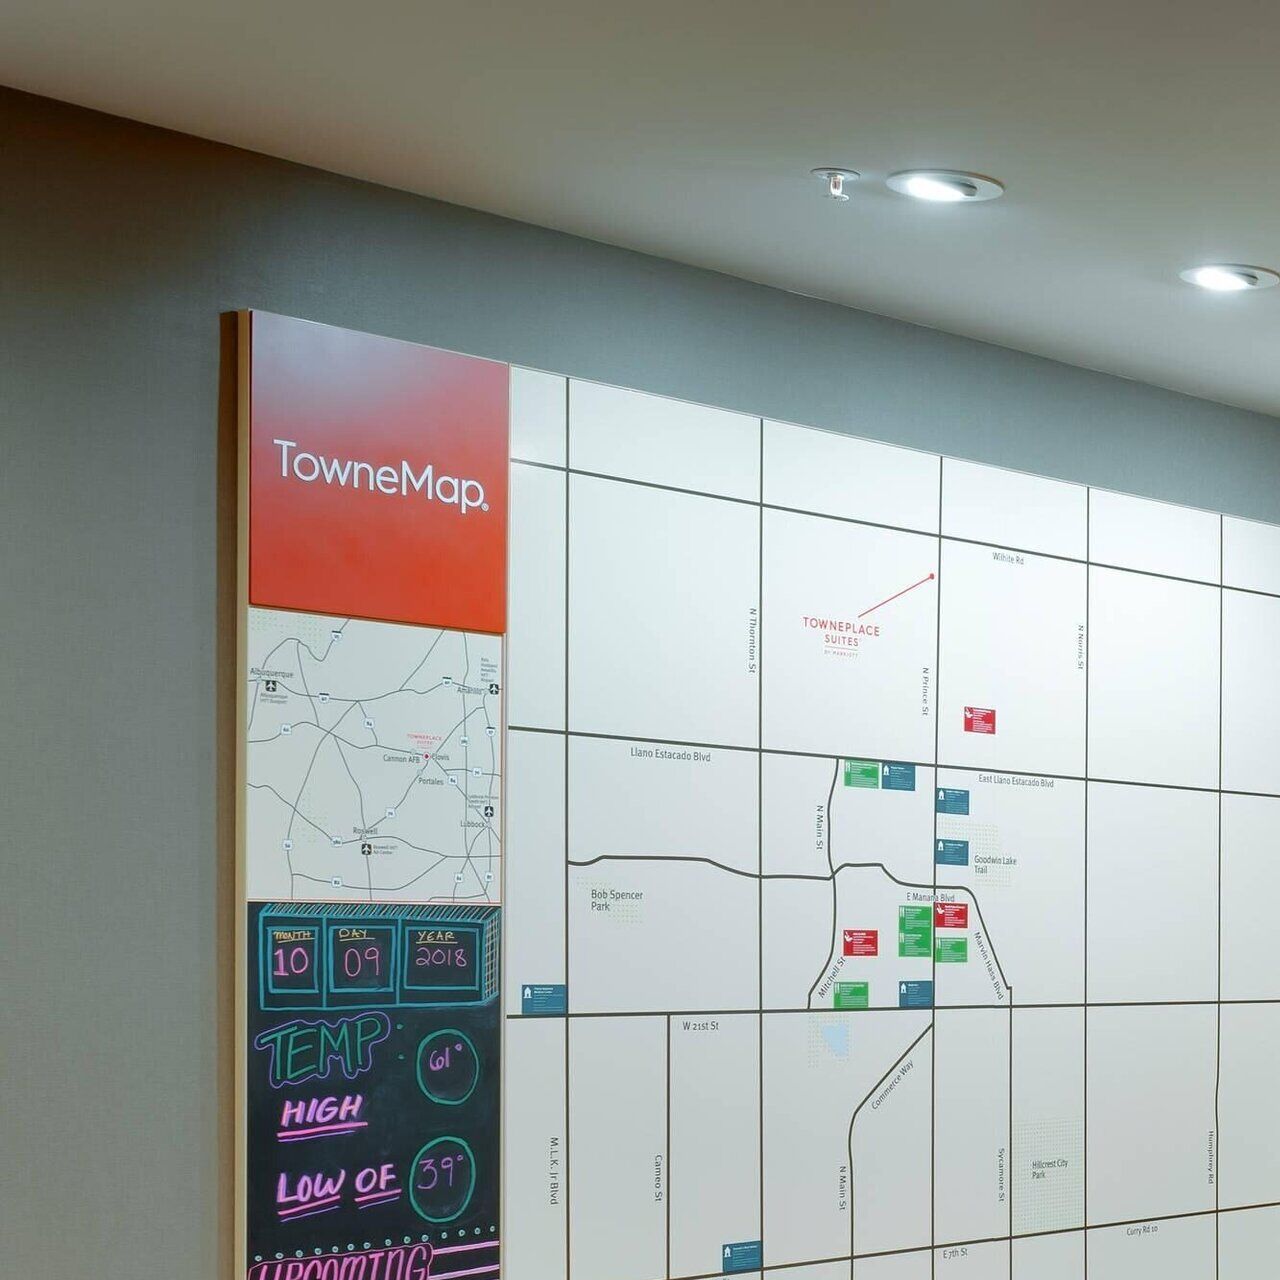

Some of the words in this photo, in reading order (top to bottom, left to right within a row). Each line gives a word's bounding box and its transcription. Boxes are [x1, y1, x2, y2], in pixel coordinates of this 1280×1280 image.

[803, 616, 880, 636] TOWNEPLACE
[749, 618, 757, 661] Thornton
[824, 634, 859, 647] SUITES
[631, 747, 653, 757] Llano
[655, 749, 692, 760] Estacado
[693, 751, 711, 762] Blvd
[591, 889, 608, 899] Bob
[610, 889, 643, 901] Spencer
[591, 901, 610, 911] Park
[339, 928, 369, 939] DAY
[418, 931, 455, 941] YEAR
[273, 947, 309, 976] 10
[345, 947, 380, 977] 09
[415, 947, 468, 967] 2018
[682, 1021, 690, 1030] W
[692, 1022, 709, 1030] 21st
[710, 1020, 719, 1030] St
[281, 1095, 364, 1127] HIGH
[654, 1154, 663, 1189] Cameo
[277, 1169, 346, 1202] LOW
[355, 1163, 397, 1193] OF
[839, 1175, 847, 1198] Main
[549, 1182, 559, 1205] Blvd
